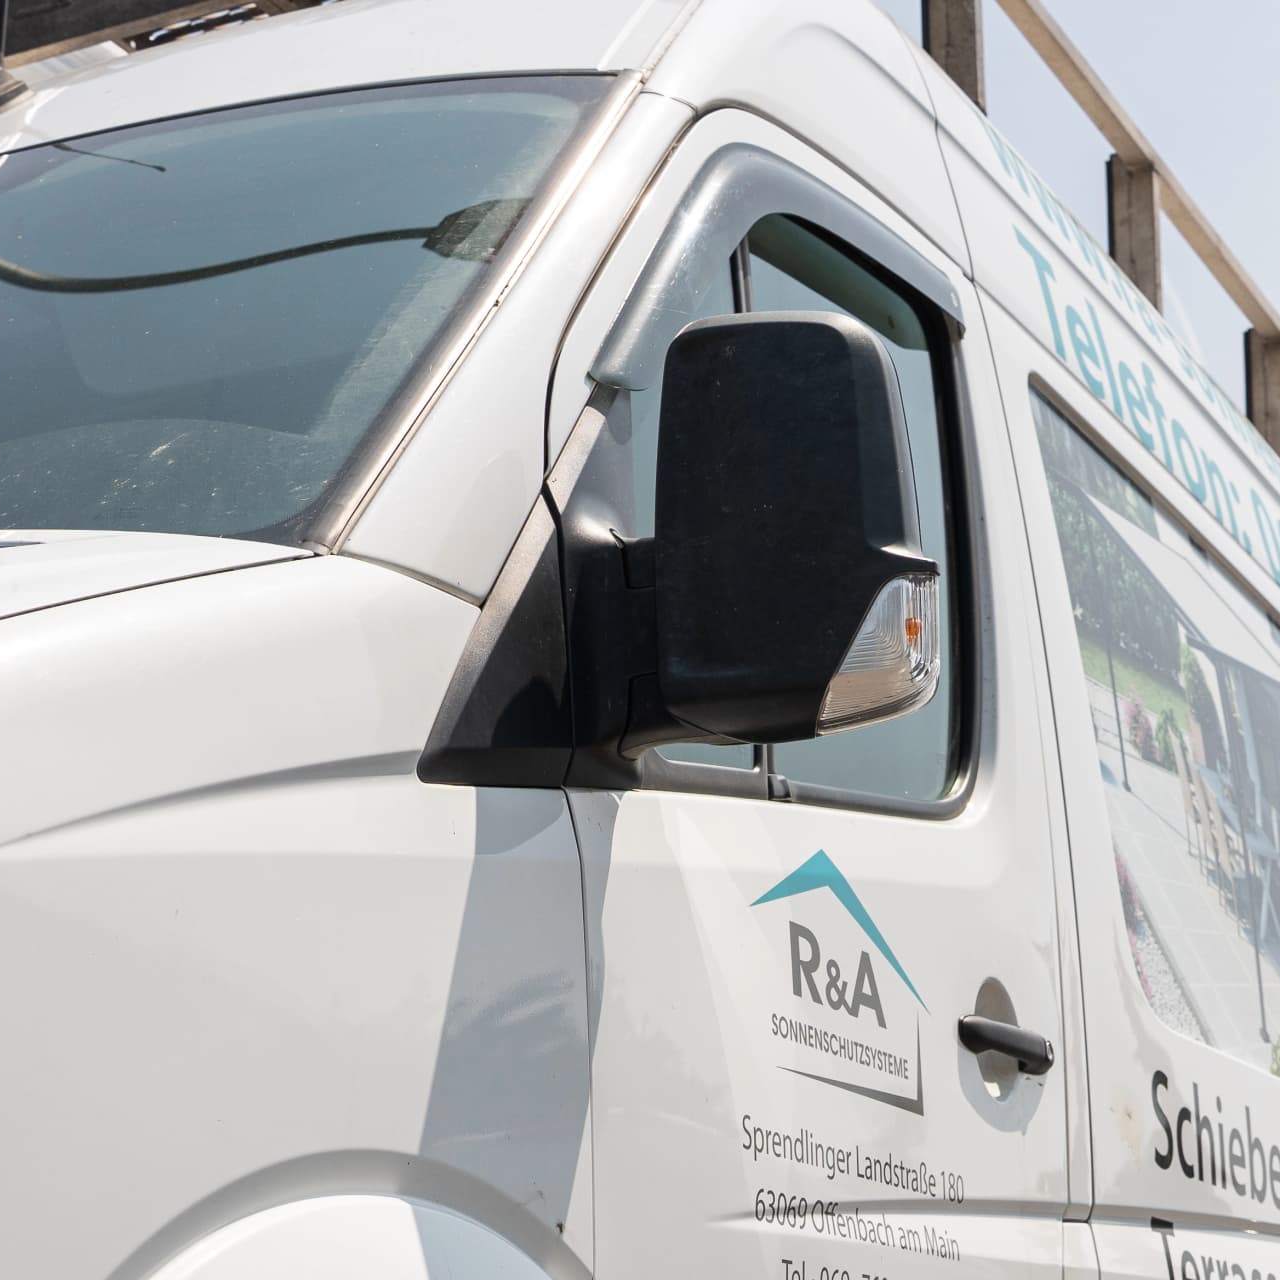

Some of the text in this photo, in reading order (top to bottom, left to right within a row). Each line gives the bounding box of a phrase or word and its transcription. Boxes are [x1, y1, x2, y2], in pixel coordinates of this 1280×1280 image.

[1011, 224, 1253, 557] Telefon:
[788, 919, 888, 1030] R&A
[771, 1012, 910, 1081] SONNENSCHUTZSYSTEME
[742, 1114, 965, 1205] Sprendlinger Landstraße 180
[754, 1187, 961, 1262] 63069 Offenbach am Main
